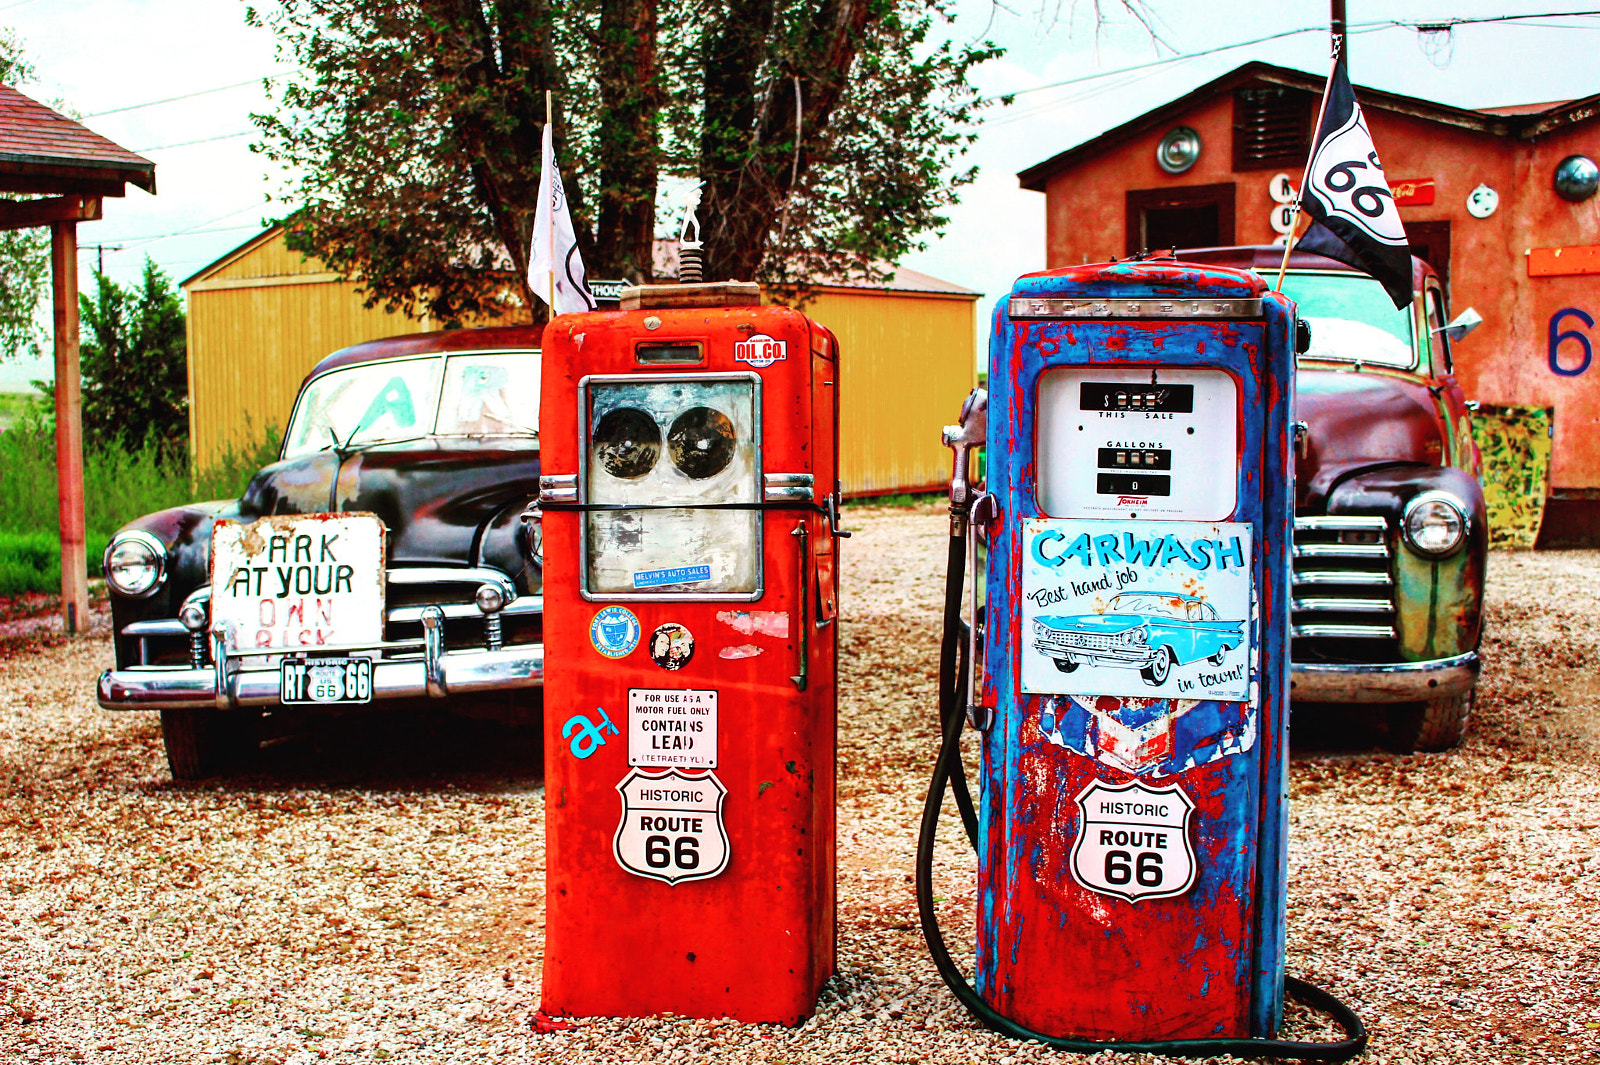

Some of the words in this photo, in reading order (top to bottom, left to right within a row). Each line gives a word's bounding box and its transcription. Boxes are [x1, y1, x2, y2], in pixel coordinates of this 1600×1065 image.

[1325, 160, 1392, 218] 66
[590, 285, 622, 298] THOUS
[1030, 302, 1232, 316] TOKHEIM
[1549, 307, 1595, 377] 6
[1098, 411, 1126, 419] THIS
[1145, 412, 1174, 420] SALE
[1106, 440, 1163, 449] GALLONS
[268, 534, 340, 563] ARK
[1030, 529, 1246, 571] CARWASH
[635, 571, 666, 580] MELVIN'S
[667, 569, 686, 578] AUTO
[687, 566, 709, 576] SALES
[232, 566, 269, 598] AT
[275, 564, 355, 599] YOUR
[1070, 573, 1113, 597] hand
[1116, 566, 1138, 591] job
[259, 598, 333, 628] OWN
[284, 664, 306, 700] RT
[345, 662, 369, 699] 66
[1177, 678, 1195, 693] in
[316, 684, 336, 698] 66
[644, 694, 661, 702] FOR
[664, 694, 680, 703] USE
[683, 695, 694, 703] AS
[695, 695, 702, 703] A
[635, 706, 664, 714] MOTOR
[667, 706, 687, 715] FUEL
[690, 707, 710, 716] ONLY
[642, 719, 704, 733] CONTAINS
[652, 734, 694, 750] LEAD
[640, 789, 704, 803] HISTORIC
[1100, 802, 1169, 818] HISTORIC
[640, 816, 703, 833] ROUTE
[1100, 830, 1168, 849] ROUTE
[645, 835, 700, 870] 66
[1104, 850, 1164, 888] 66
